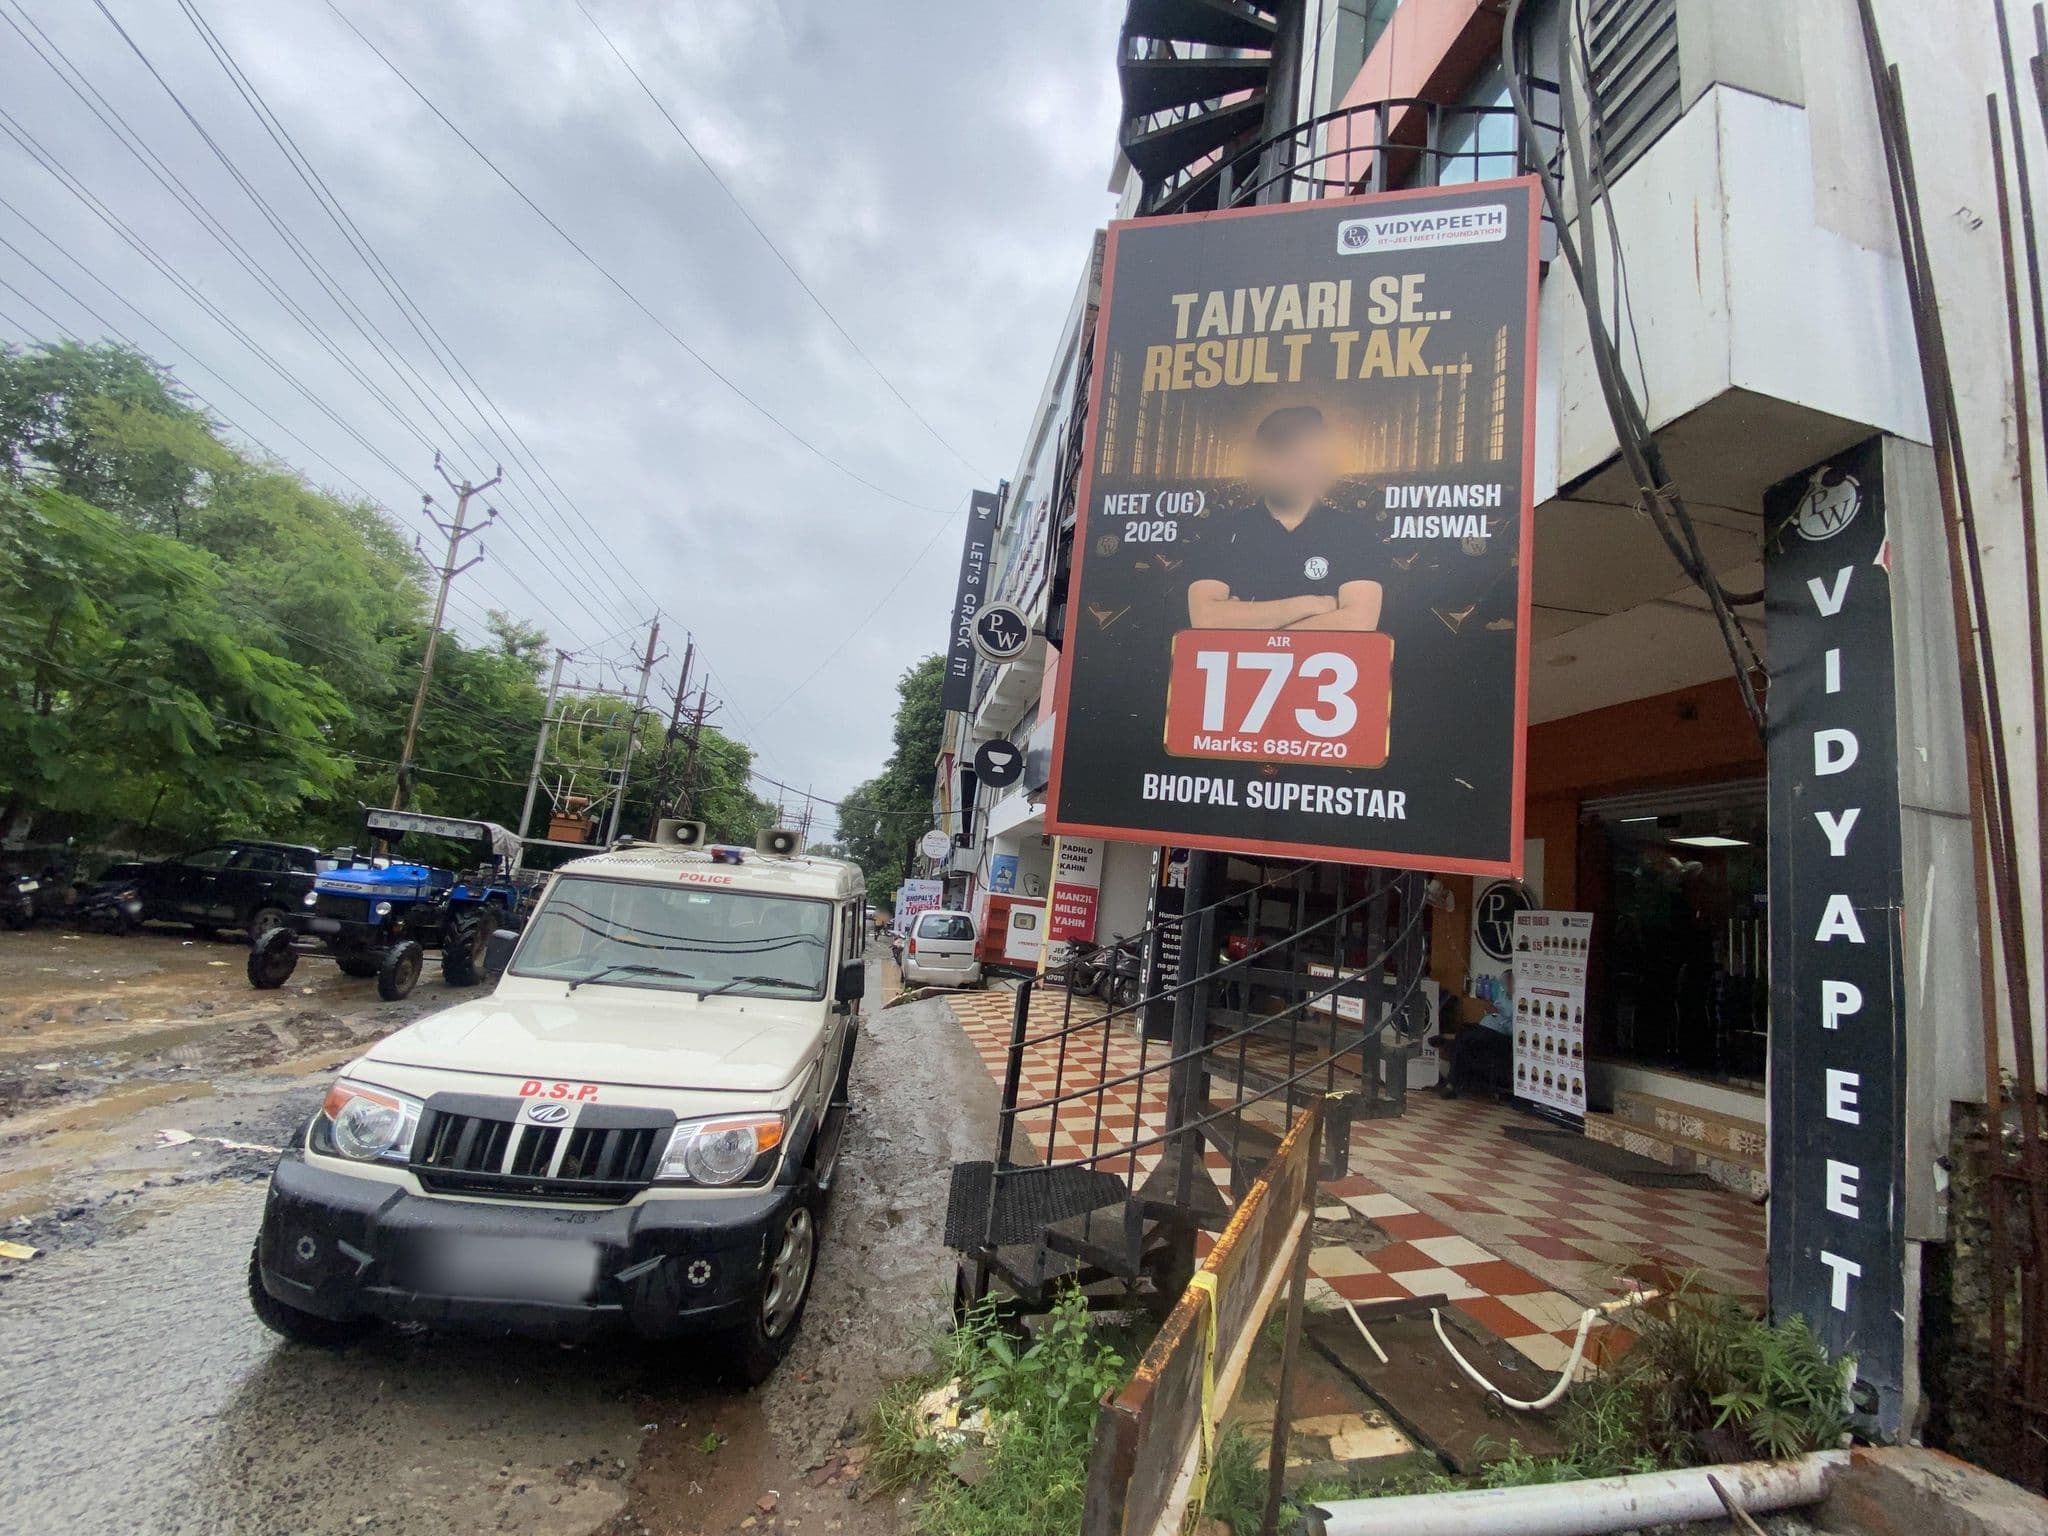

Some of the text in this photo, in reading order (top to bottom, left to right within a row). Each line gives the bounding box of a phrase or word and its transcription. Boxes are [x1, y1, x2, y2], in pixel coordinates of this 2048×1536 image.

[1375, 212, 1502, 236] VIDYAPEETH
[1414, 234, 1435, 243] NEET
[1442, 227, 1502, 240] FOUNDATION
[1172, 273, 1452, 340] TAIYARI SE..
[1143, 326, 1473, 392] RESULT TAK...
[1103, 489, 1205, 517] NEET (UG)
[1385, 484, 1501, 509] DIVYANSH
[1124, 521, 1178, 543] 2026
[1390, 514, 1492, 538] JAISWAL
[953, 542, 985, 677] LET'S CRACK IT!
[1266, 636, 1290, 647] AIR
[1196, 651, 1358, 738] 173
[1193, 735, 1347, 758] Marks: 685/720
[1143, 773, 1406, 820] BHOPAL SUPERSTAR
[1061, 853, 1088, 863] CHAHE
[1062, 844, 1094, 855] PADHLO
[679, 872, 733, 885] POLICE
[1060, 863, 1085, 872] KAHIN
[1056, 891, 1093, 904] MANZIL
[1055, 903, 1087, 915] MILEGI
[1054, 916, 1086, 928] YAHIN
[1163, 931, 1170, 939] in
[520, 1080, 598, 1102] D.S.P.
